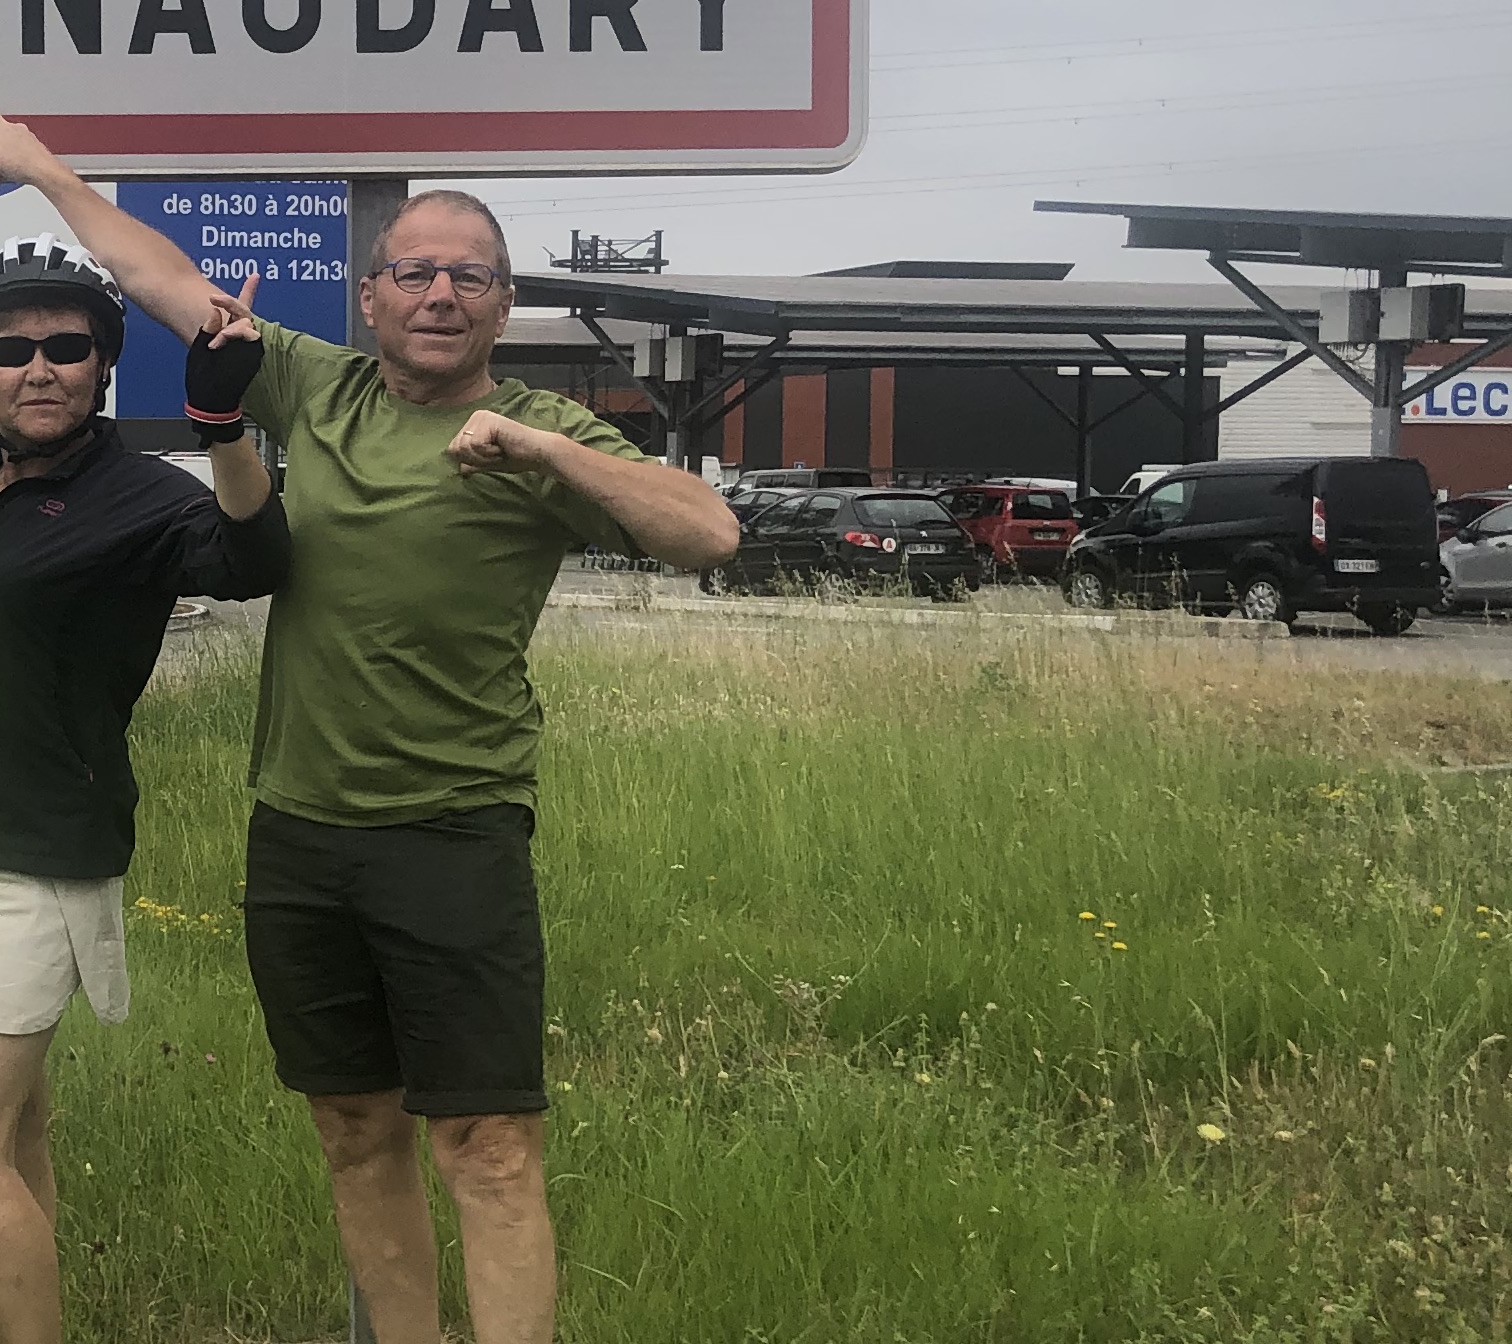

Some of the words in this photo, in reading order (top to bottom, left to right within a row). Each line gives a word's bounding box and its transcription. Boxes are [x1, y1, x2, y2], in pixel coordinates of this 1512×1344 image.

[163, 193, 192, 215] de
[199, 193, 257, 216] 8h30
[265, 194, 278, 216] à
[201, 225, 322, 249] Dimanche
[200, 258, 258, 280] 9h00
[265, 258, 278, 280] à
